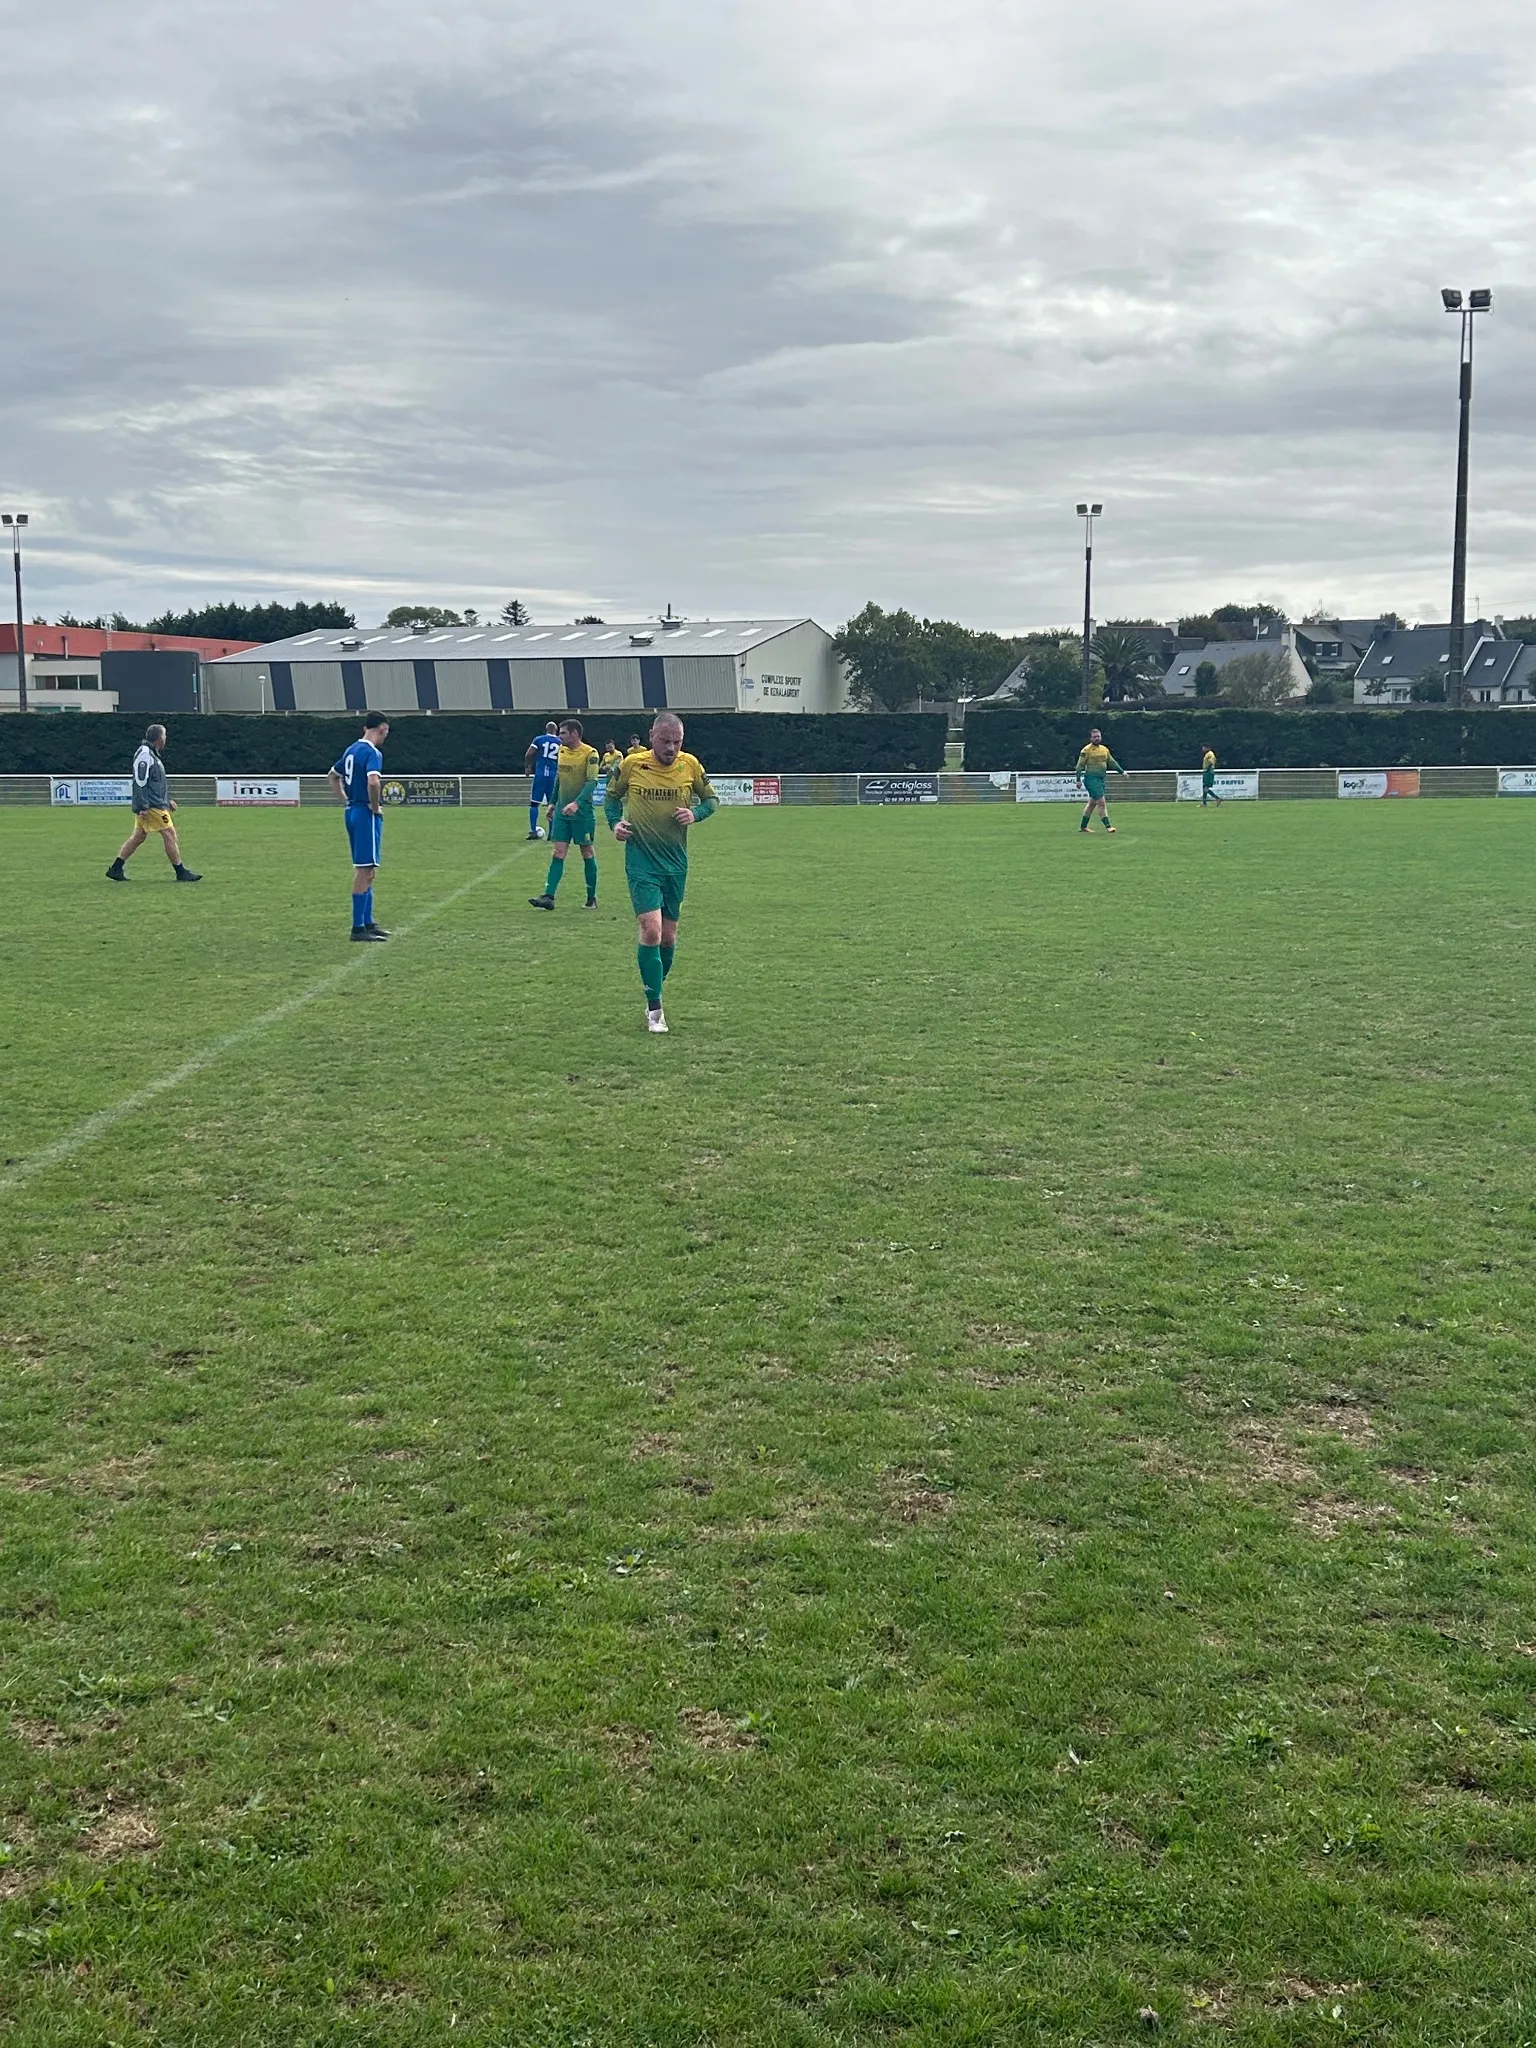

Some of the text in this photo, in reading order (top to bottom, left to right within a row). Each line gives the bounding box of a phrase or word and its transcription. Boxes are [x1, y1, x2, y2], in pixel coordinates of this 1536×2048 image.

[761, 674, 784, 685] COMPLEXE
[785, 676, 802, 686] SPORTIF
[763, 686, 770, 696] DE
[542, 741, 560, 760] 12
[344, 754, 354, 786] 9
[233, 780, 279, 795] ims
[408, 781, 456, 789] Food-truck
[890, 780, 933, 791] actiglass
